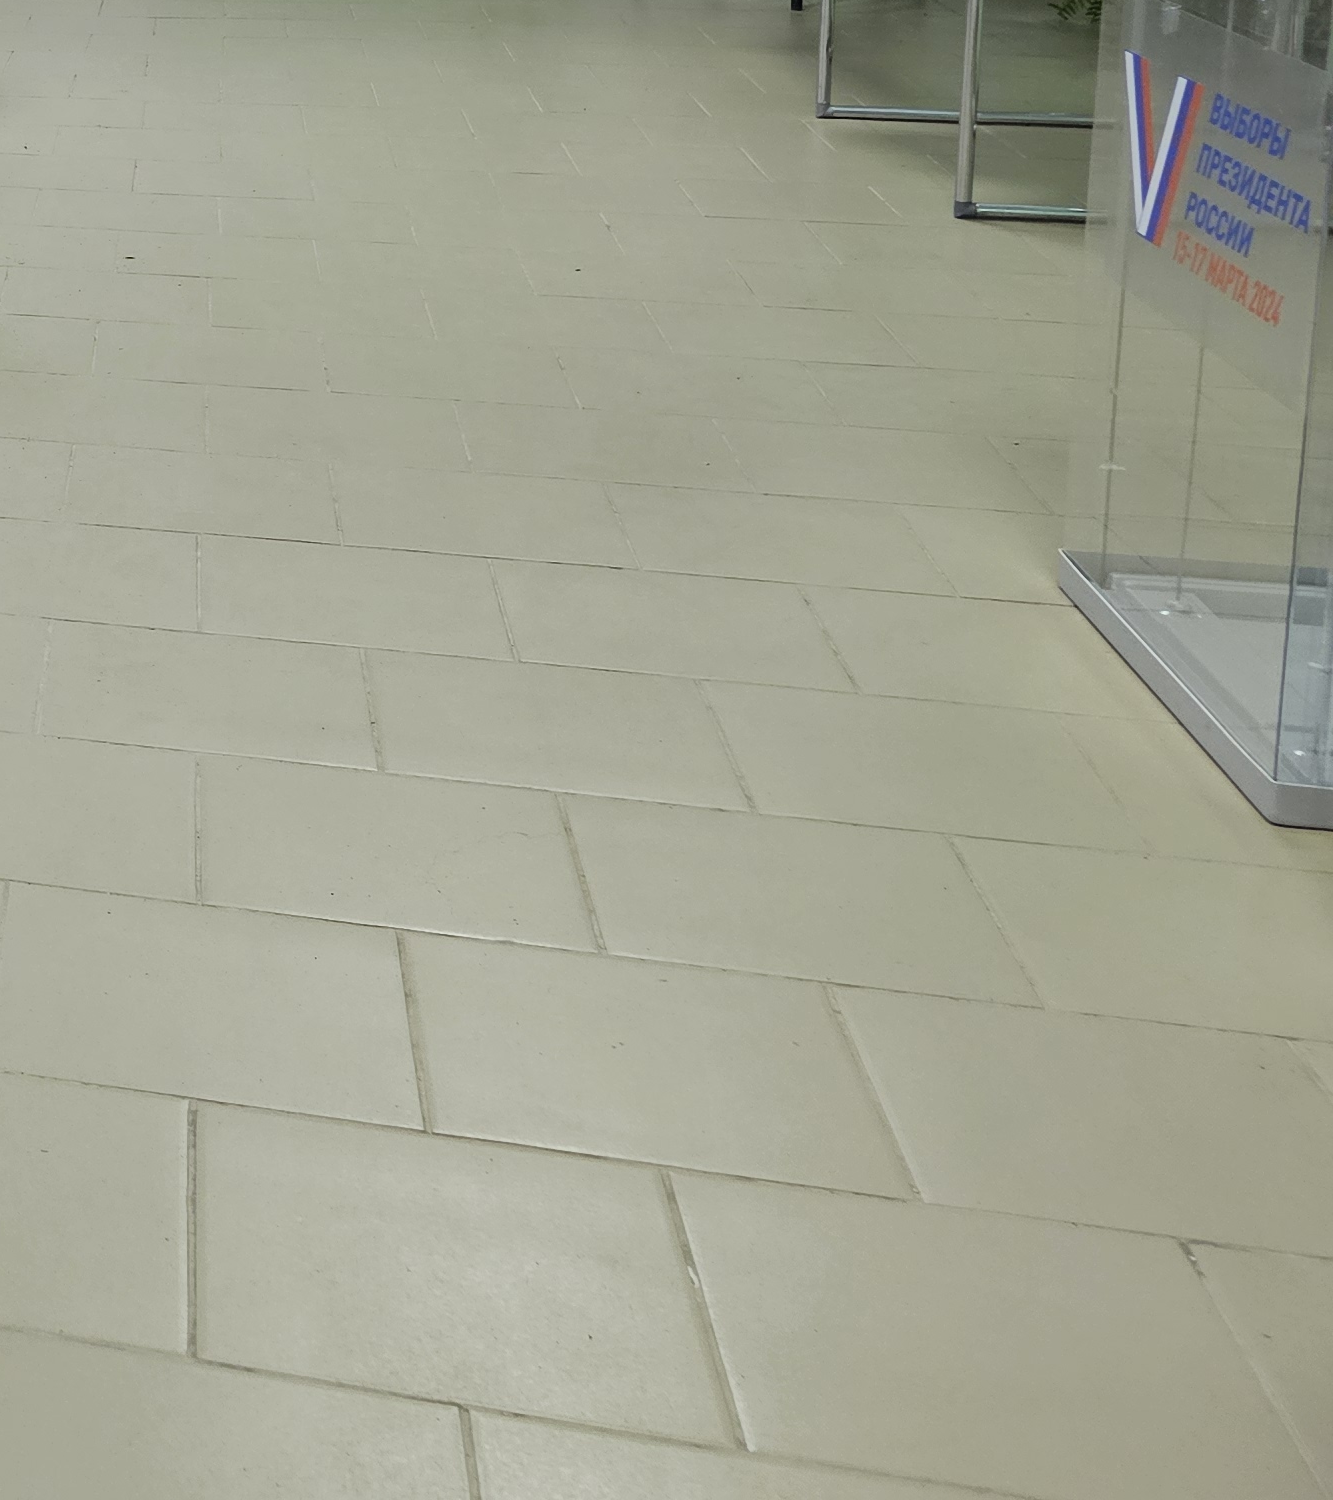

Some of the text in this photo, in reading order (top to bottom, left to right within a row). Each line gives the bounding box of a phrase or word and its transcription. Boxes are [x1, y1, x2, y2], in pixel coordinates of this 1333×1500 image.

[1208, 92, 1293, 161] ВЫБОРЫ
[1184, 191, 1256, 259] РОССИИ
[1194, 142, 1312, 235] ПРЕЗИДЕНТА
[1172, 230, 1286, 328] 15-17 МАРТА 2024
